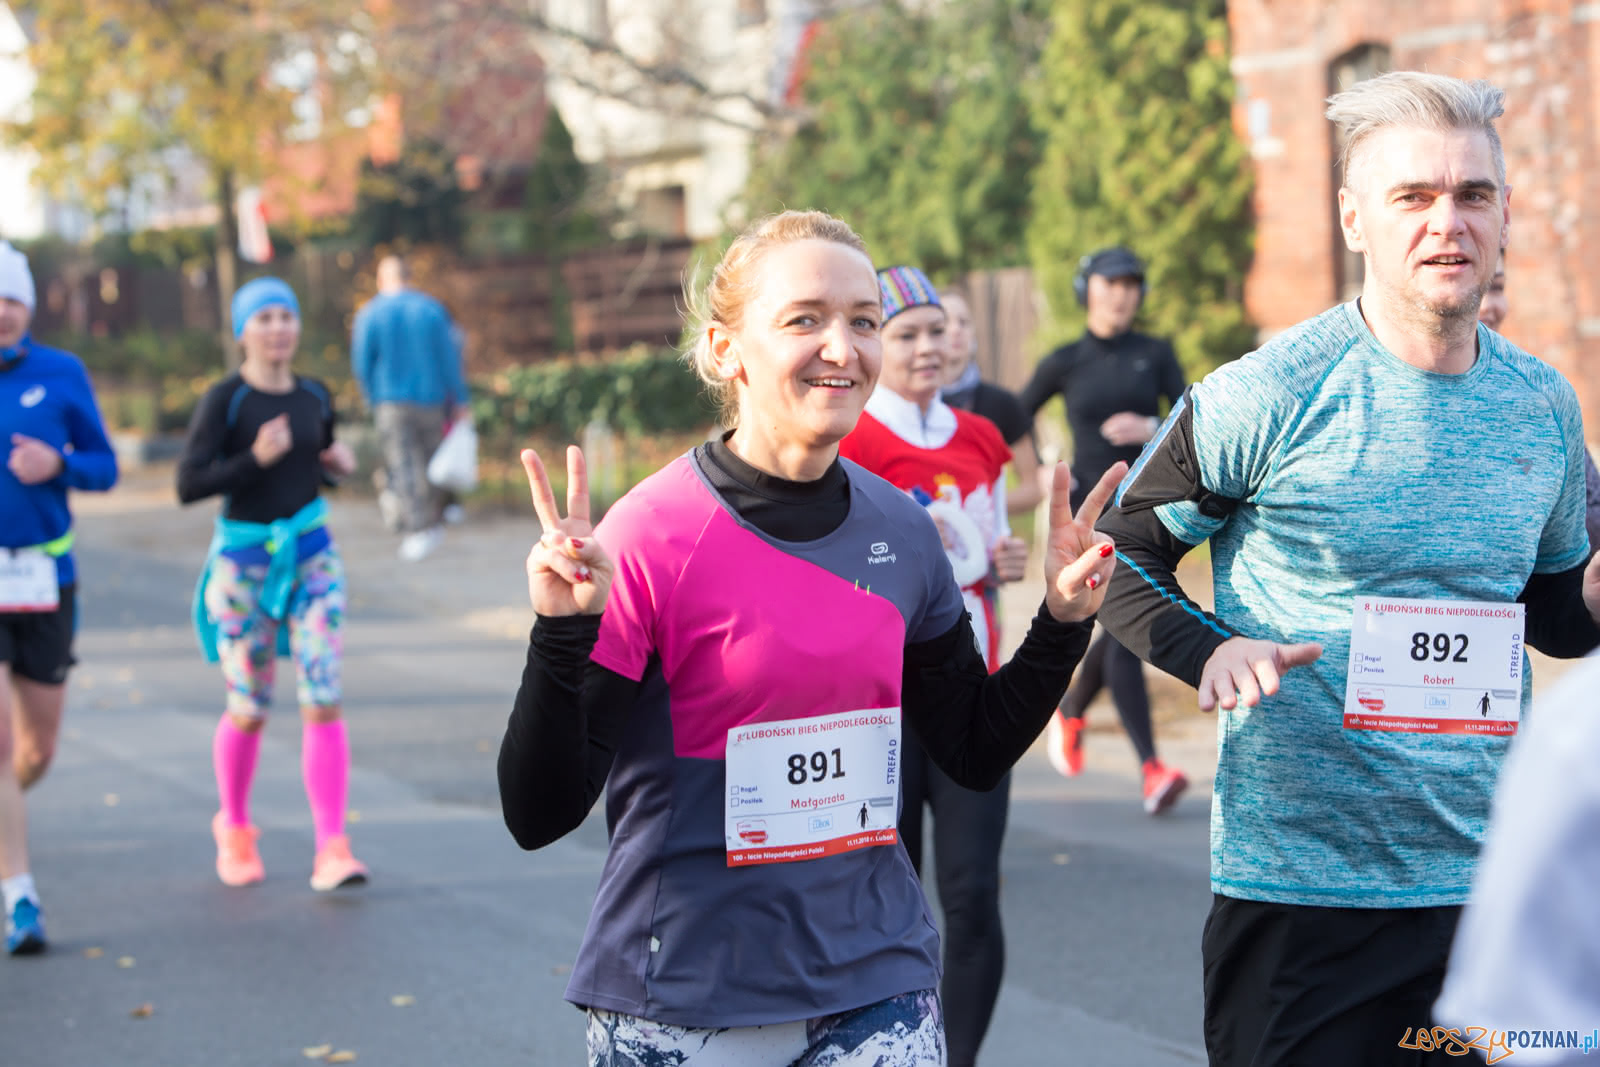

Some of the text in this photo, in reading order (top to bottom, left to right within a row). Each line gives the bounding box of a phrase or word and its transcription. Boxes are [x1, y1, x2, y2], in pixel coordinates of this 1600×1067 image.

[867, 553, 897, 565] Kalenji
[1375, 602, 1423, 614] LUBOŃSKI
[1425, 606, 1444, 616] BIEG
[1446, 607, 1516, 619] NIEPODLEGŁOŚCI
[1410, 631, 1469, 663] 892
[1510, 633, 1520, 678] STREFA D
[1423, 674, 1455, 685] Robert
[746, 726, 796, 740] LUBOŃSKI
[798, 723, 818, 735] BIEG
[820, 714, 895, 732] NIEPODLEGŁOŚCI
[1422, 722, 1439, 730] Polski
[1464, 723, 1491, 731] 11.11.2018
[787, 747, 846, 785] 891
[886, 749, 897, 785] STREFA
[790, 792, 846, 809] Małgorzata
[846, 835, 871, 847] 11.11.2018
[732, 854, 743, 862] 100
[808, 846, 825, 856] Polski
